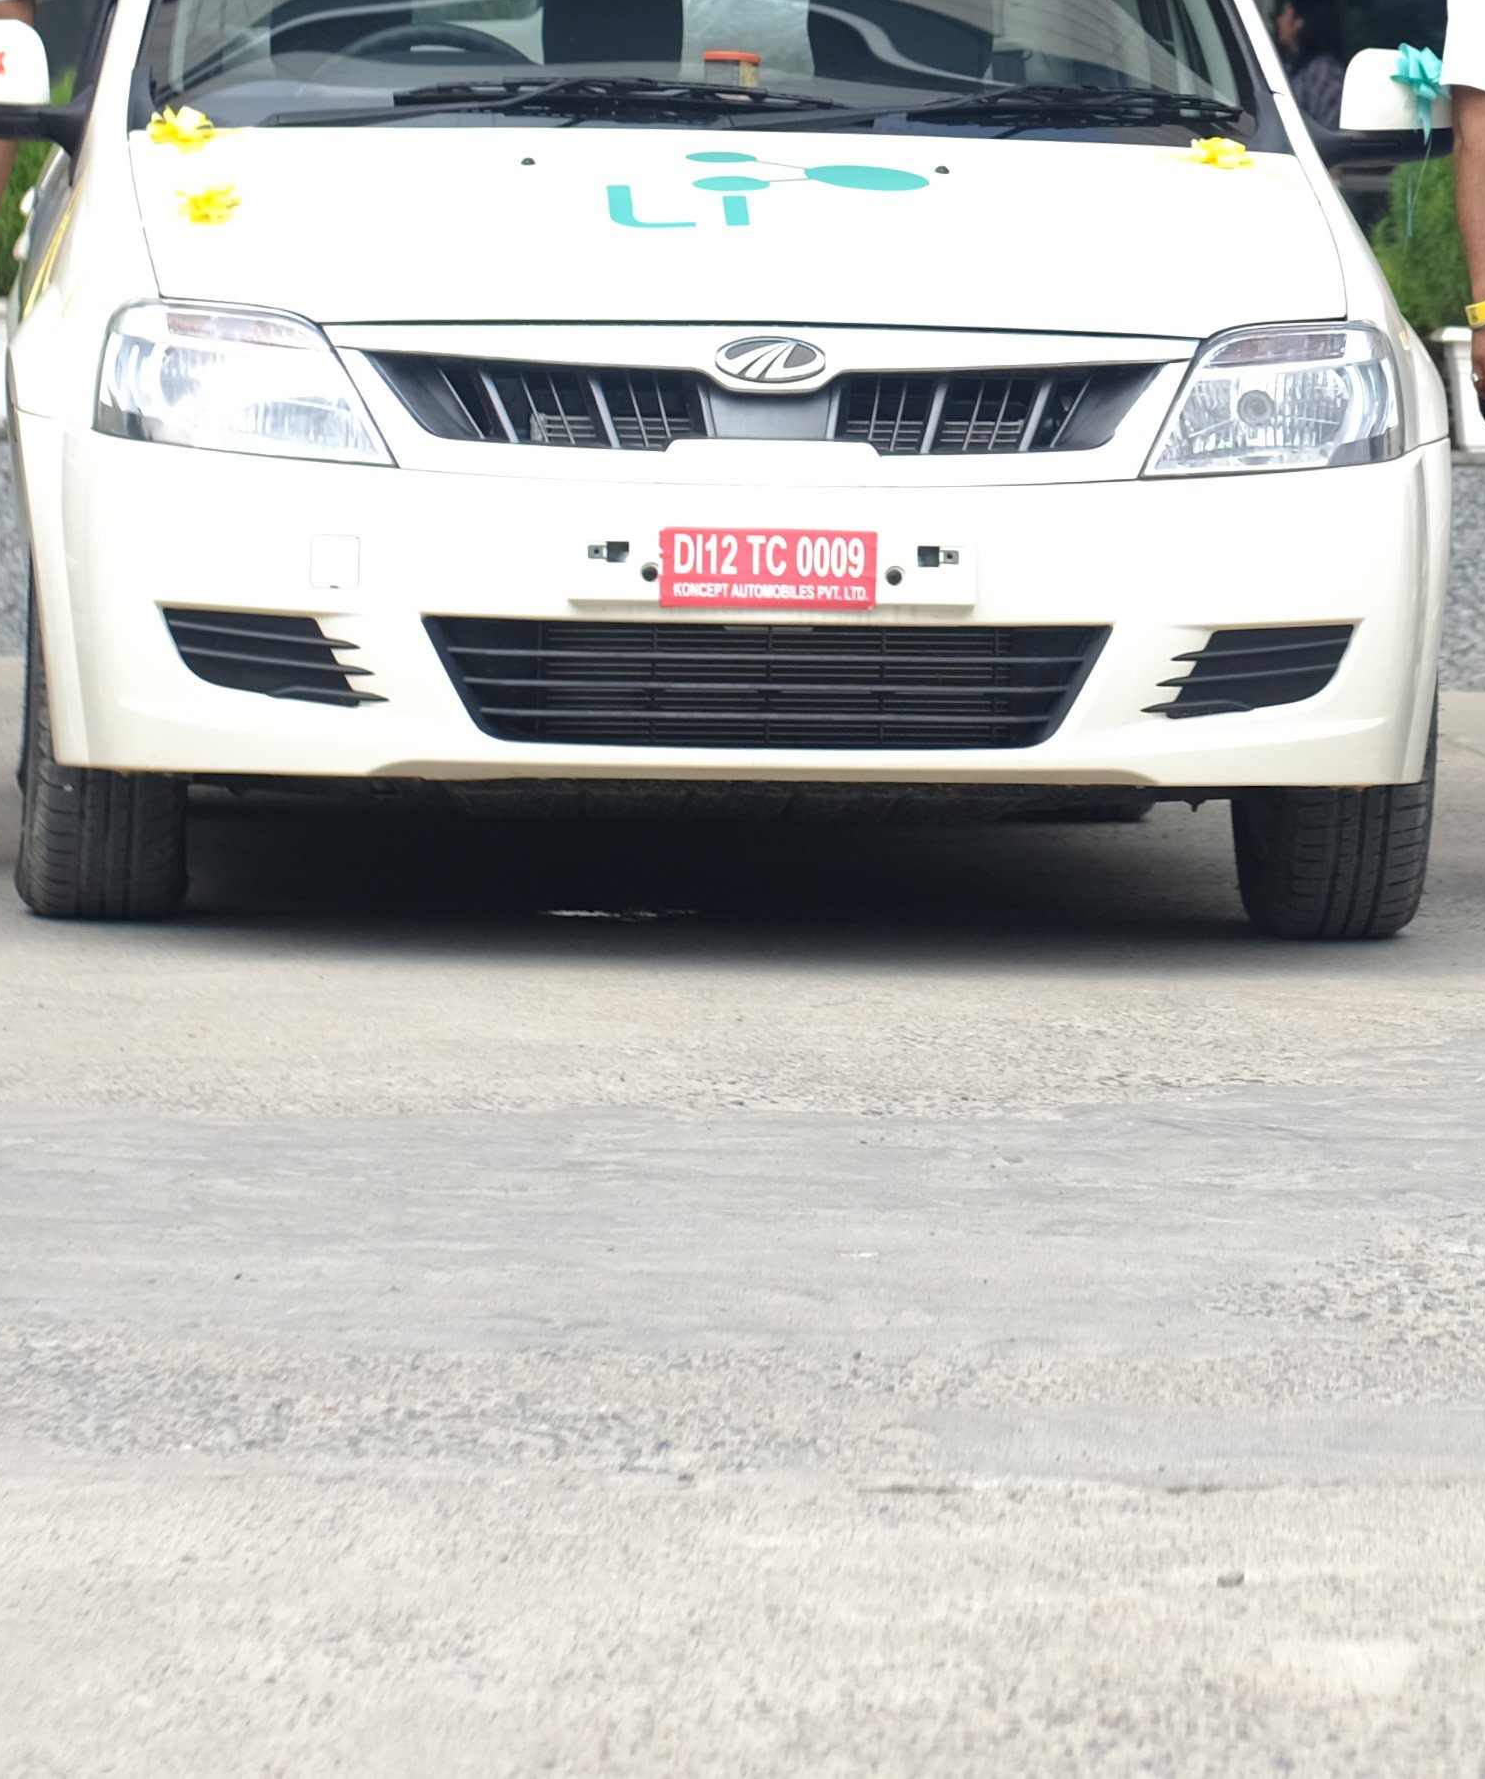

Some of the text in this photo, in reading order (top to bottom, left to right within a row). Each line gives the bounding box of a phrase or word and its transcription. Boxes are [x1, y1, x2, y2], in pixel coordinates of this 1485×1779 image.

[746, 535, 788, 577] TC
[796, 536, 865, 579] 0009
[672, 581, 730, 598] KONCEPT
[731, 583, 815, 600] AUTOMOBILES
